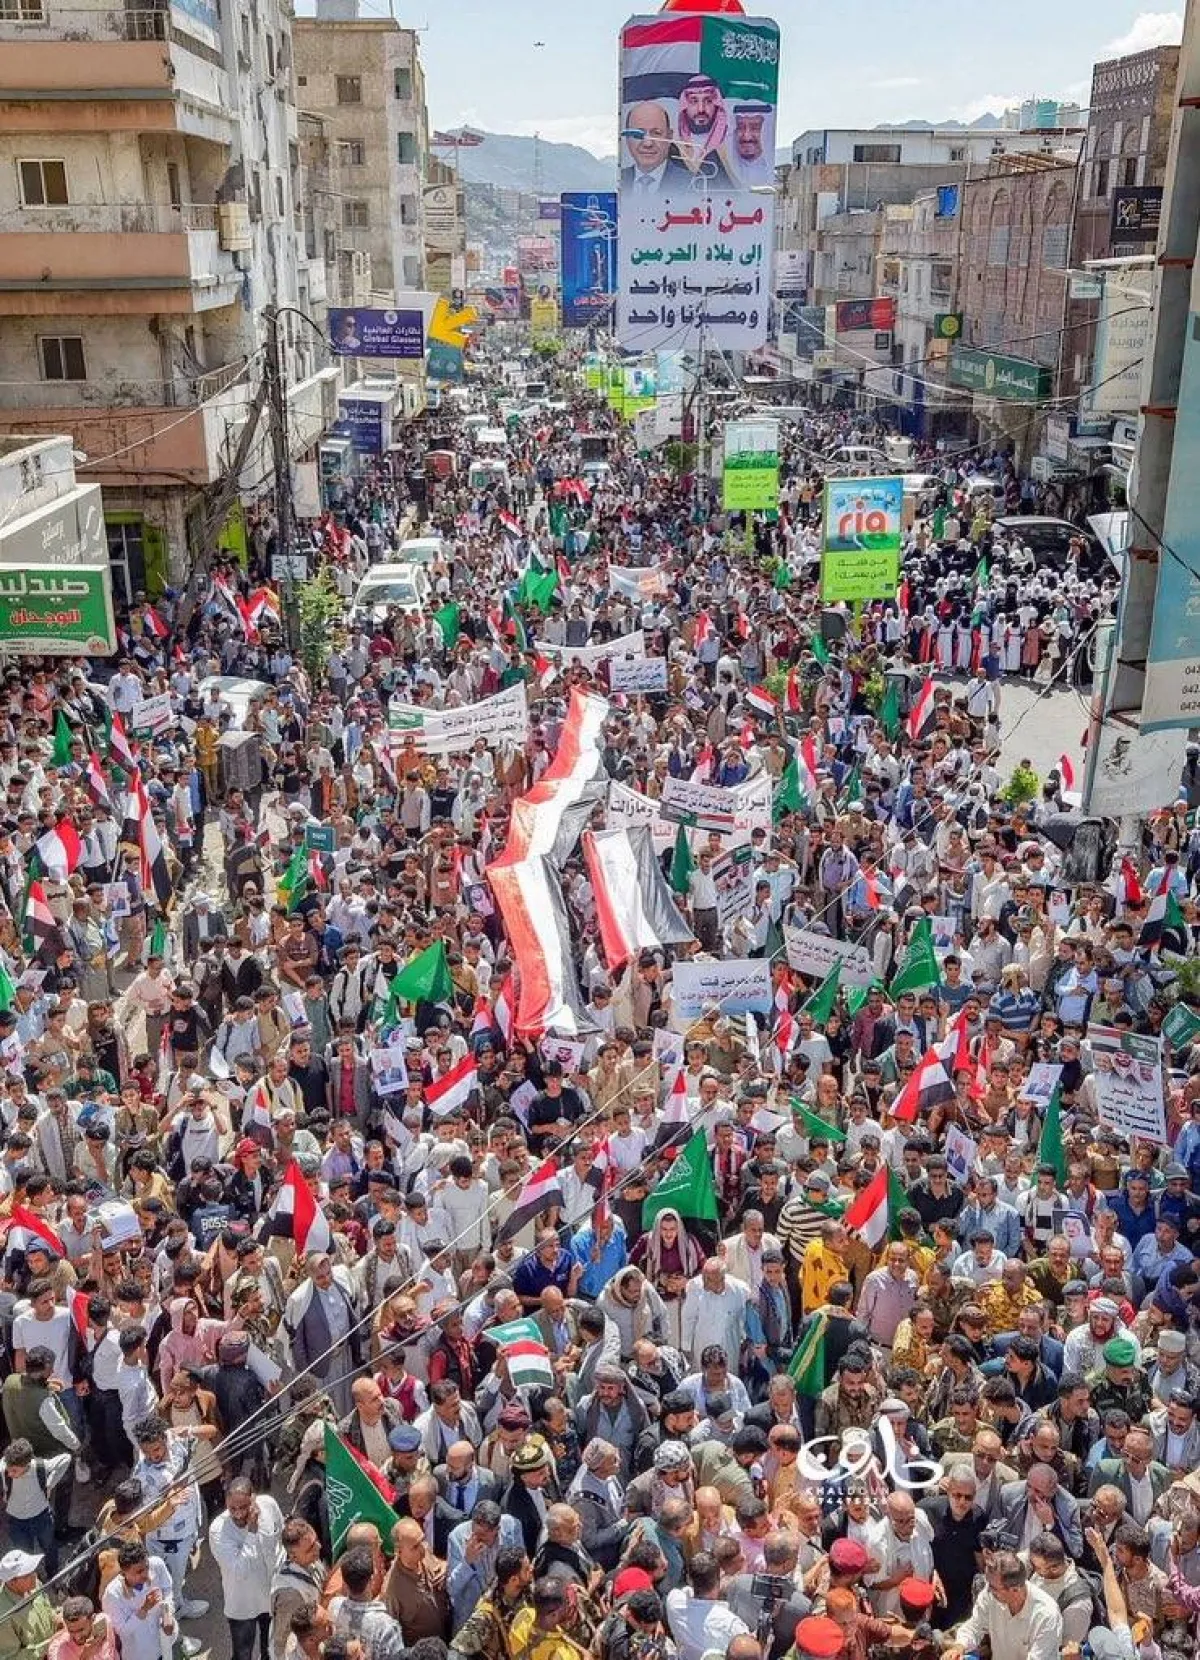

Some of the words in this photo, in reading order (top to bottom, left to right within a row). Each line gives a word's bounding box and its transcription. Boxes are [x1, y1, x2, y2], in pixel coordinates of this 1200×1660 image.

[719, 200, 763, 233] من
[631, 243, 697, 266] الحرمين
[705, 244, 734, 266] بلاد
[739, 243, 762, 267] إلى
[629, 275, 677, 298] واحد
[628, 305, 676, 328] واحد
[838, 499, 888, 542] ria
[0, 571, 90, 603] صيدلي
[10, 607, 82, 628] الوجدان
